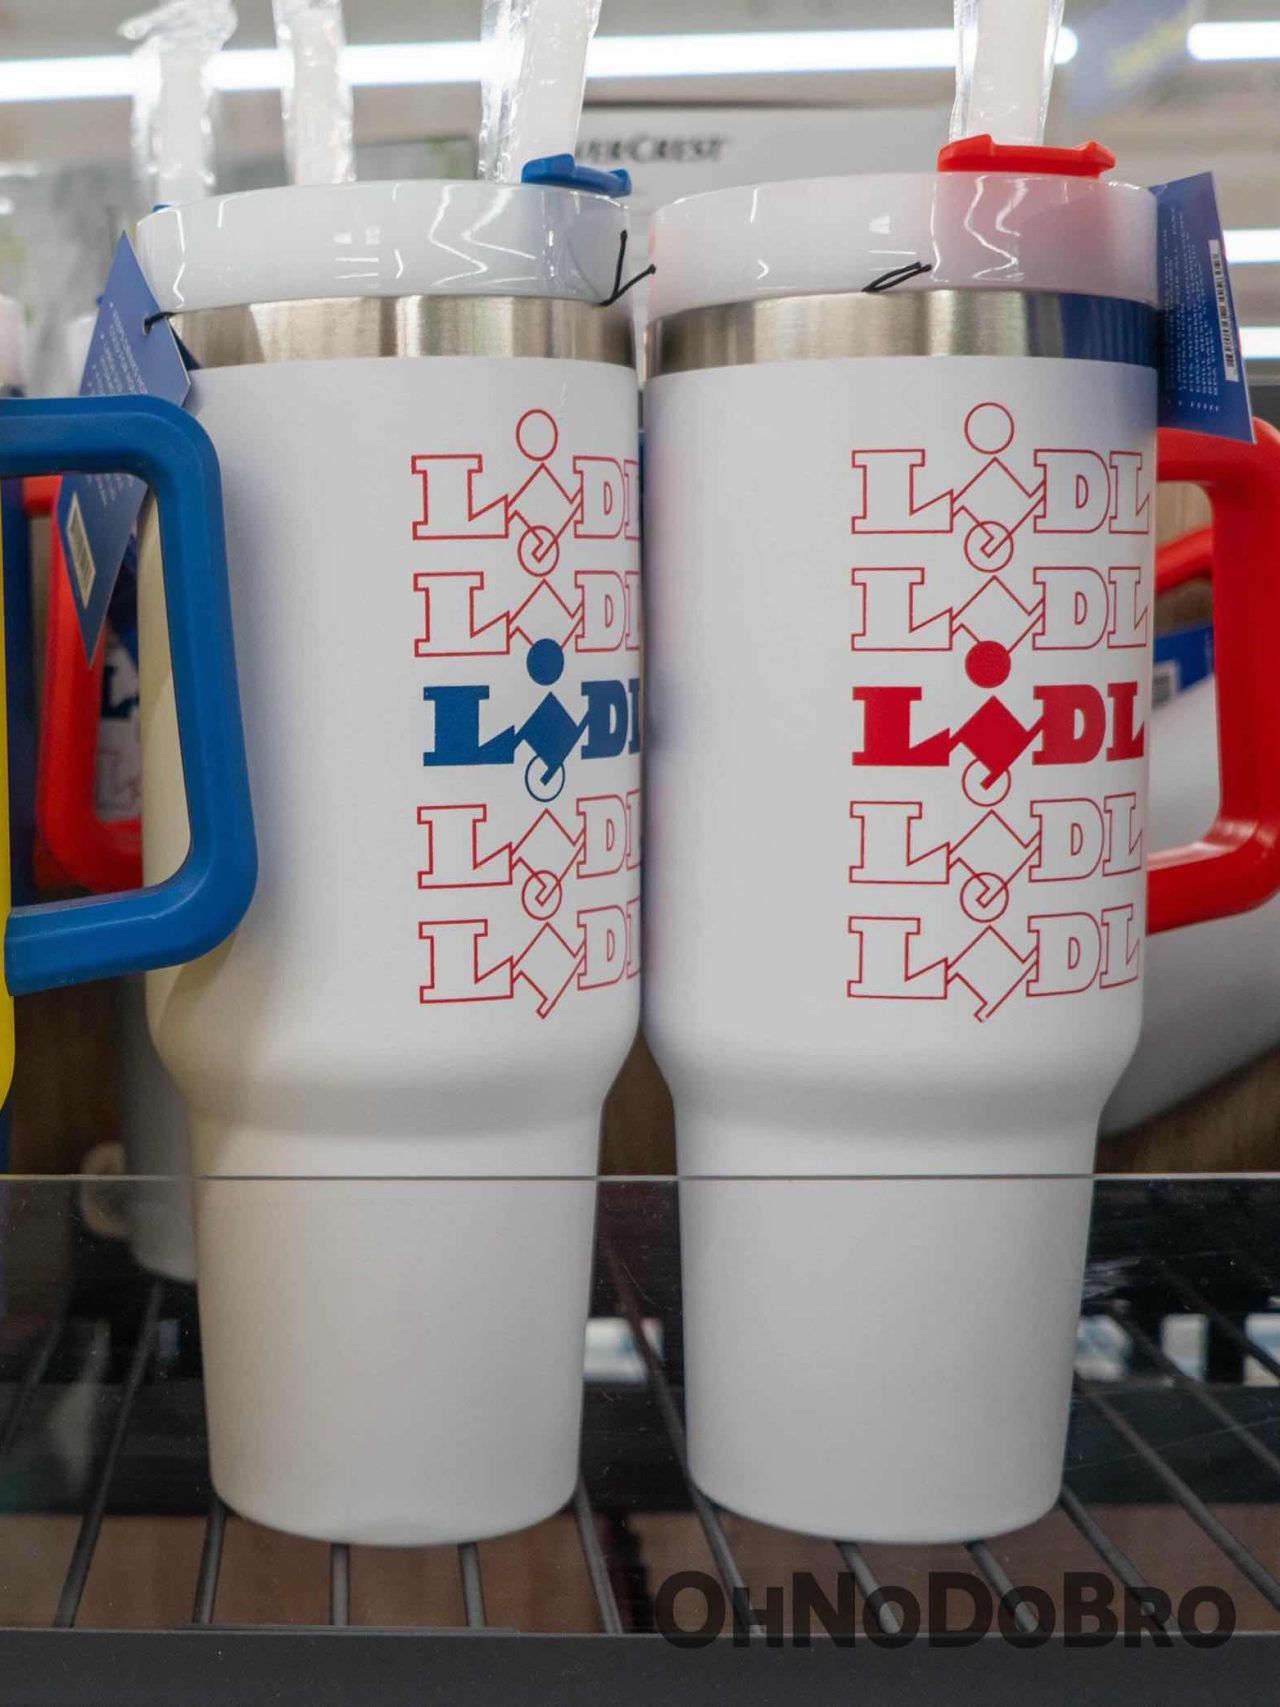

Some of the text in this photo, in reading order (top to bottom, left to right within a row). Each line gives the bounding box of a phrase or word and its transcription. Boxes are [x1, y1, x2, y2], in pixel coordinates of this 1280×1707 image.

[851, 402, 1150, 559] LIDL
[850, 521, 1148, 651] LIDL
[851, 640, 1145, 791] LIDL
[848, 756, 1143, 909] LIDL
[846, 871, 1140, 1023] LIDL
